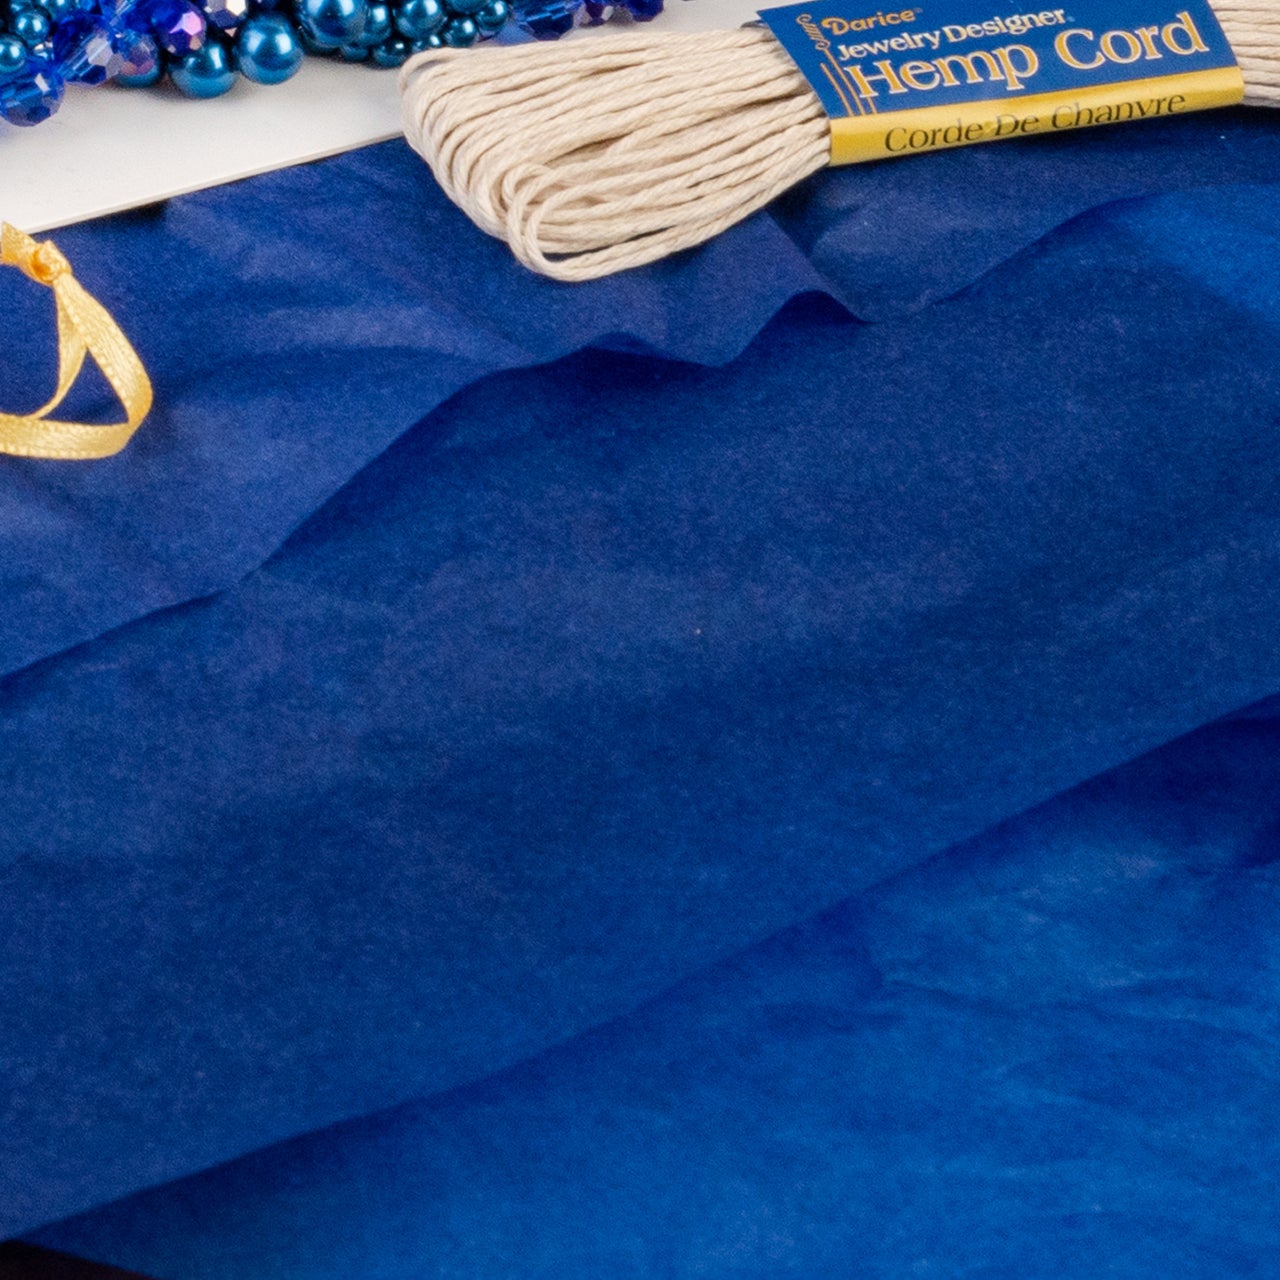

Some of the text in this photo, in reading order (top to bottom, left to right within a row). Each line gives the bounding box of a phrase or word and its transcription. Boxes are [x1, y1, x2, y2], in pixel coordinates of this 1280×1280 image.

[837, 29, 940, 61] Jewelry
[843, 10, 1210, 99] Hemp Cord
[884, 93, 1186, 154] Corde De Chanvre
